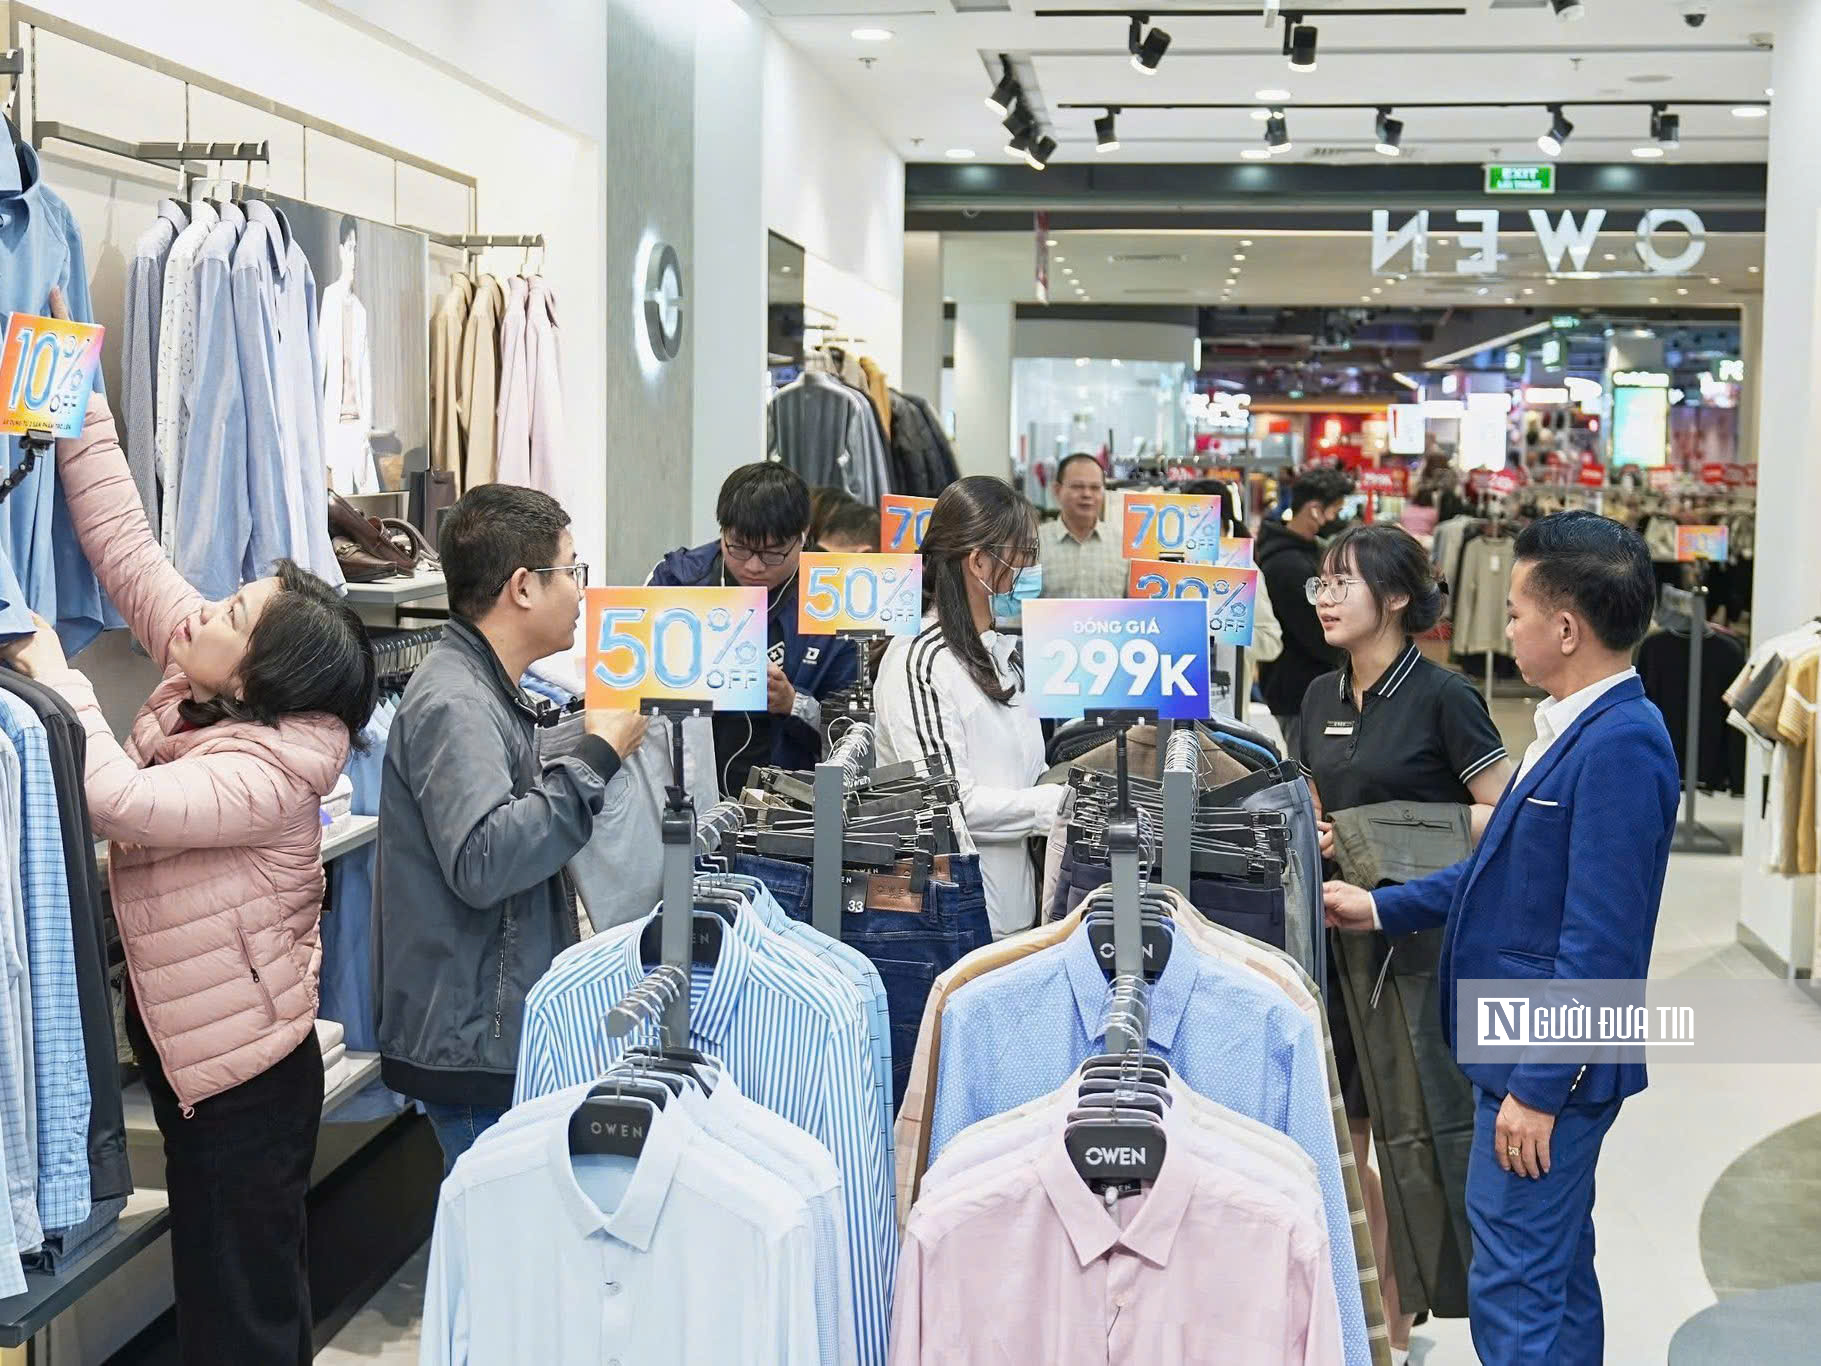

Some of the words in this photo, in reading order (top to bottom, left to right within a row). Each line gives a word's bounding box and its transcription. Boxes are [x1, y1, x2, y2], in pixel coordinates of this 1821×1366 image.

[8, 328, 91, 411] 10%
[1128, 504, 1215, 549] 70%
[1186, 538, 1215, 550] OFF
[803, 567, 914, 622] 50%
[880, 608, 915, 622] OFF
[1126, 616, 1161, 634] GIÁ
[1209, 618, 1246, 633] OFF
[594, 607, 758, 689] 50%
[1042, 638, 1199, 696] 299K
[706, 671, 758, 689] OFF
[1100, 942, 1154, 959] ON
[591, 1121, 643, 1138] OWEN
[1085, 1146, 1147, 1166] OWEN
